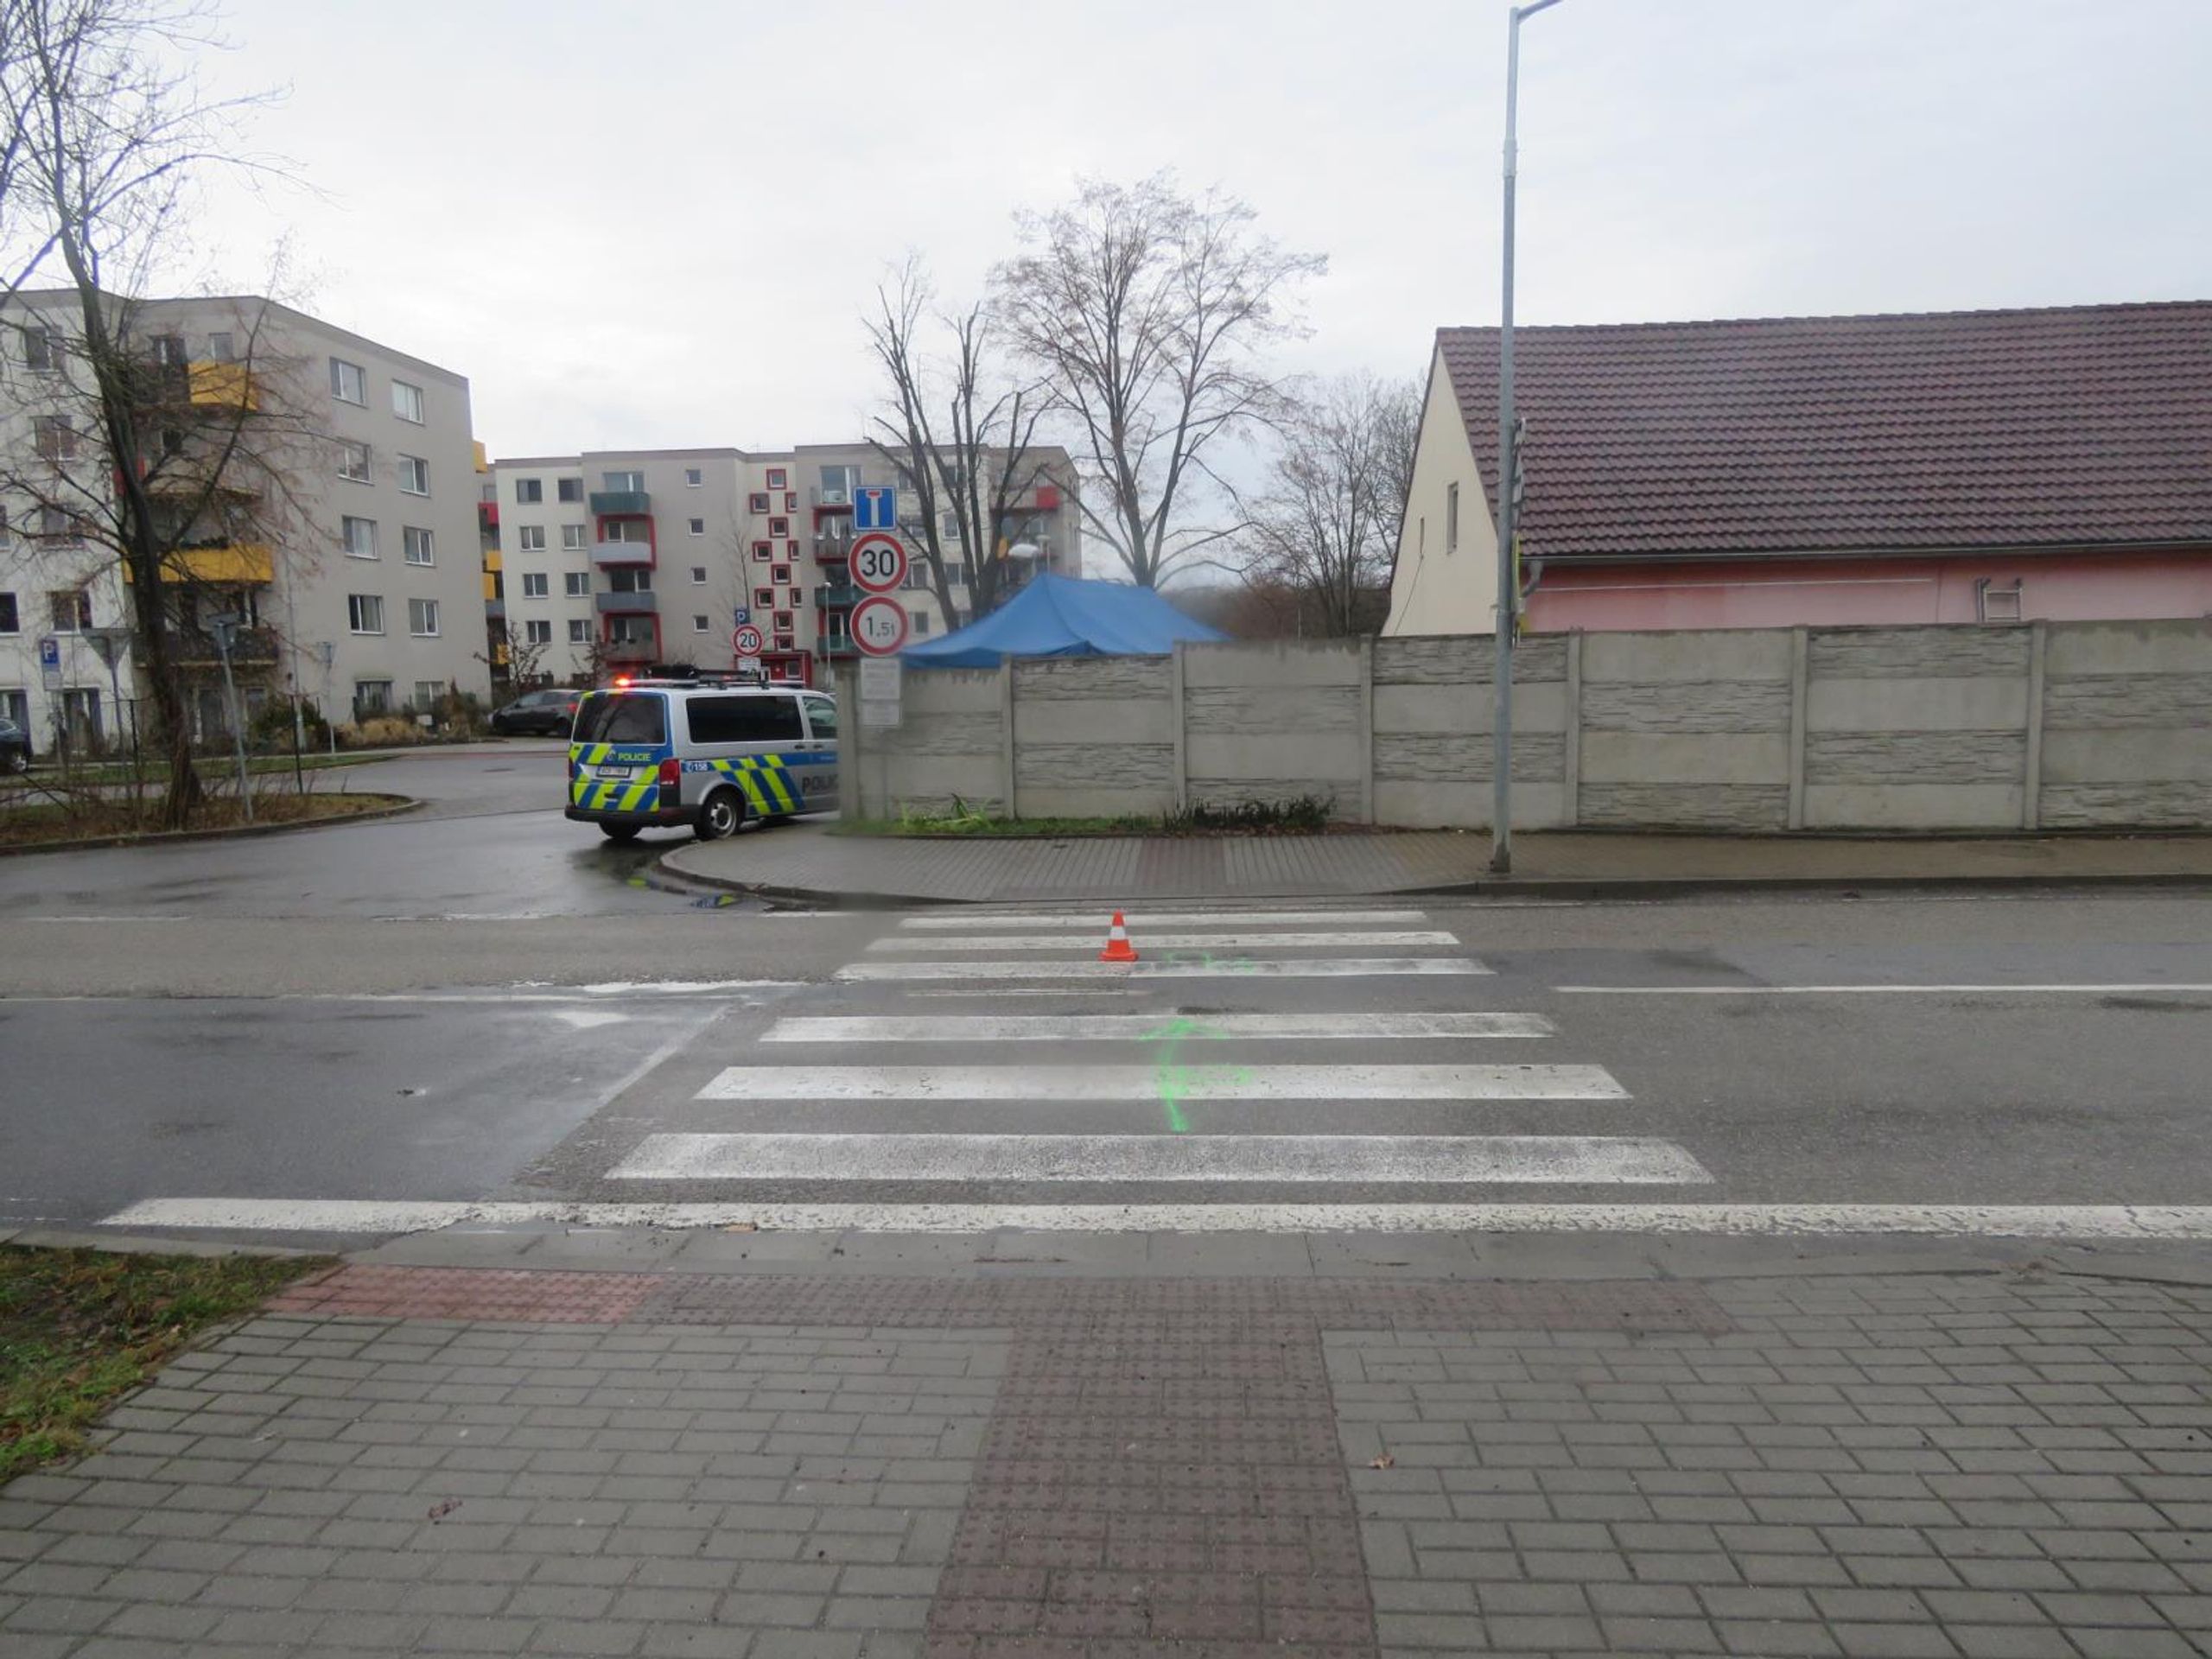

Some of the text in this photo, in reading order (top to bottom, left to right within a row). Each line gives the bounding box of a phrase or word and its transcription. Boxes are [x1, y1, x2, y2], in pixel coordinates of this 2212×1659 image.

[861, 550, 894, 577] 30
[740, 632, 757, 648] 20
[618, 753, 651, 761] POLICIE
